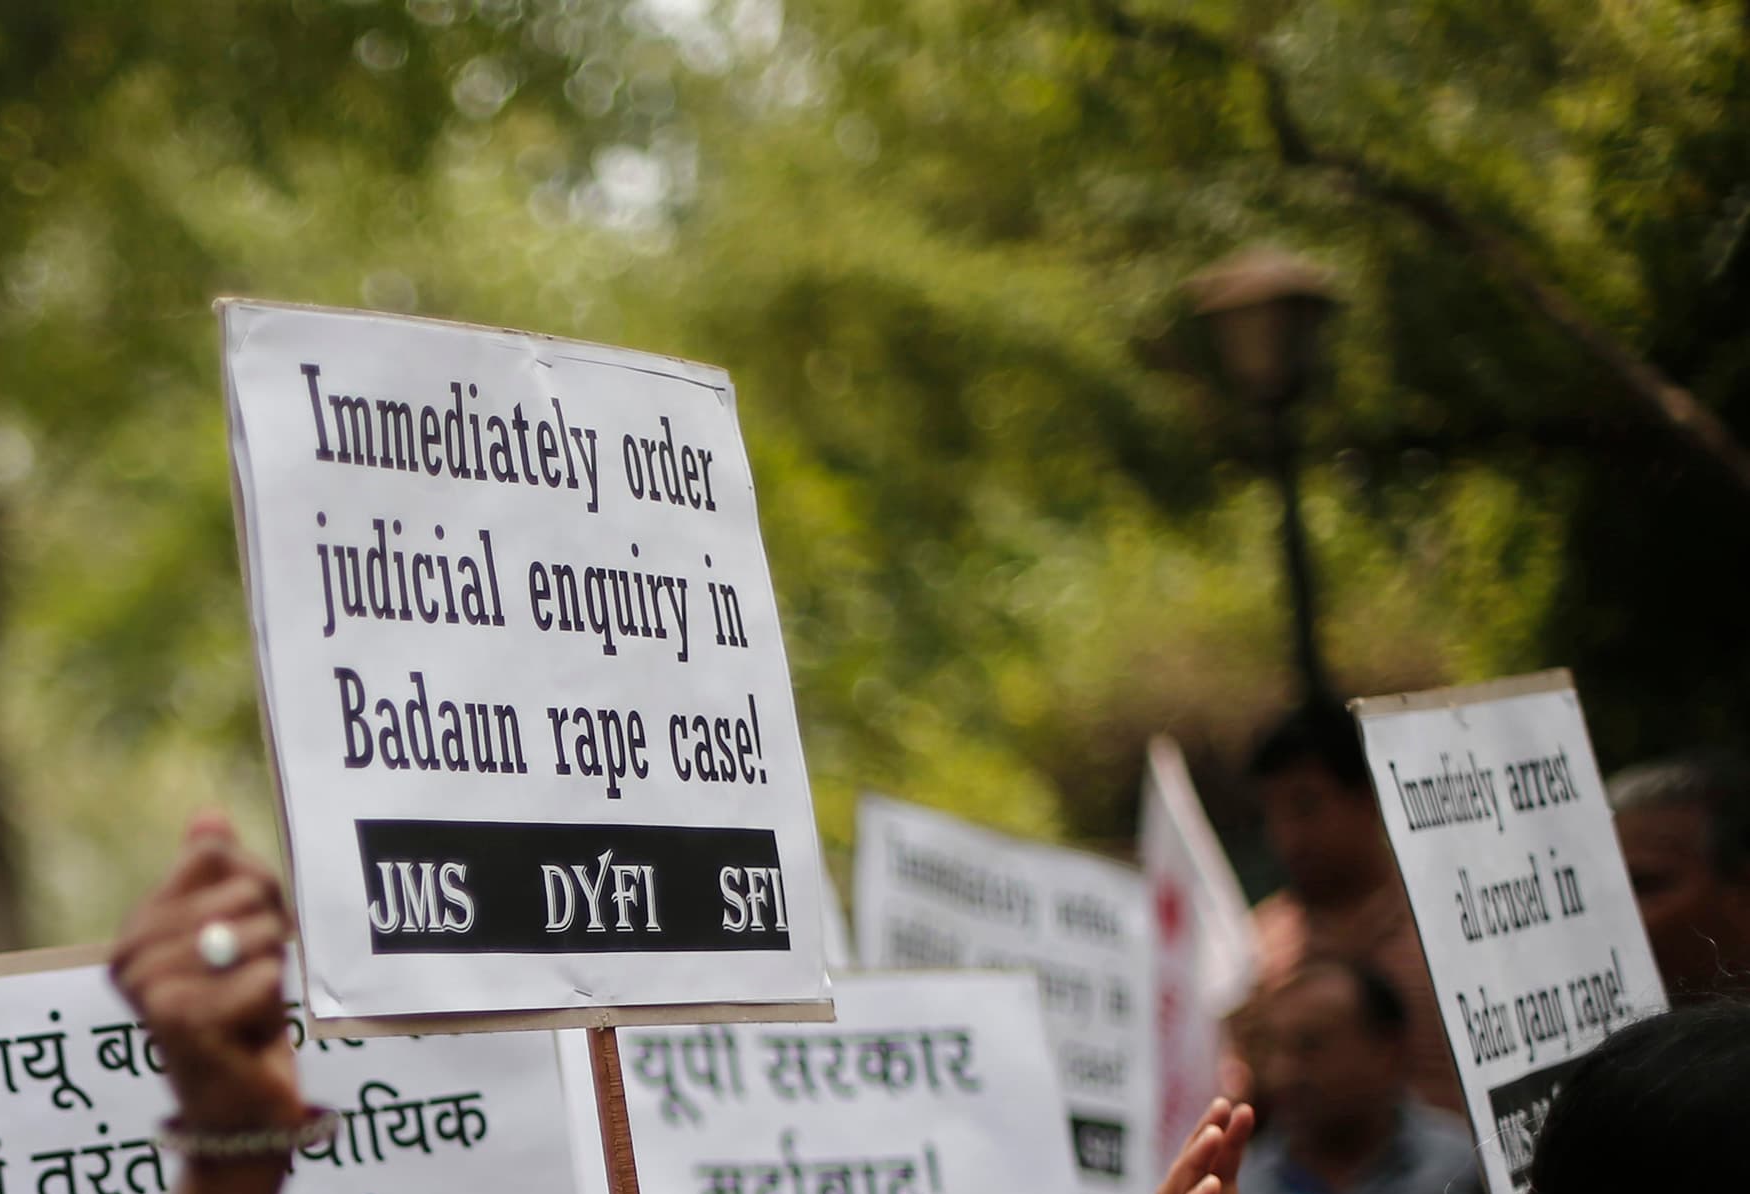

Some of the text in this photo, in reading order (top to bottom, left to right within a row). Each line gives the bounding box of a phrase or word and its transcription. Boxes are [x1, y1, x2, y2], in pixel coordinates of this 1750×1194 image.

[300, 363, 716, 513] Immediately order
[316, 512, 748, 663] judicial enquiry in
[333, 667, 768, 798] Badaun rape case!
[1504, 744, 1581, 812] arrest
[369, 849, 788, 934] JMS DYFI SFI
[1549, 848, 1586, 918] in
[1514, 986, 1571, 1064] gang
[1566, 946, 1635, 1037] rape!
[758, 1026, 985, 1100] सरकार
